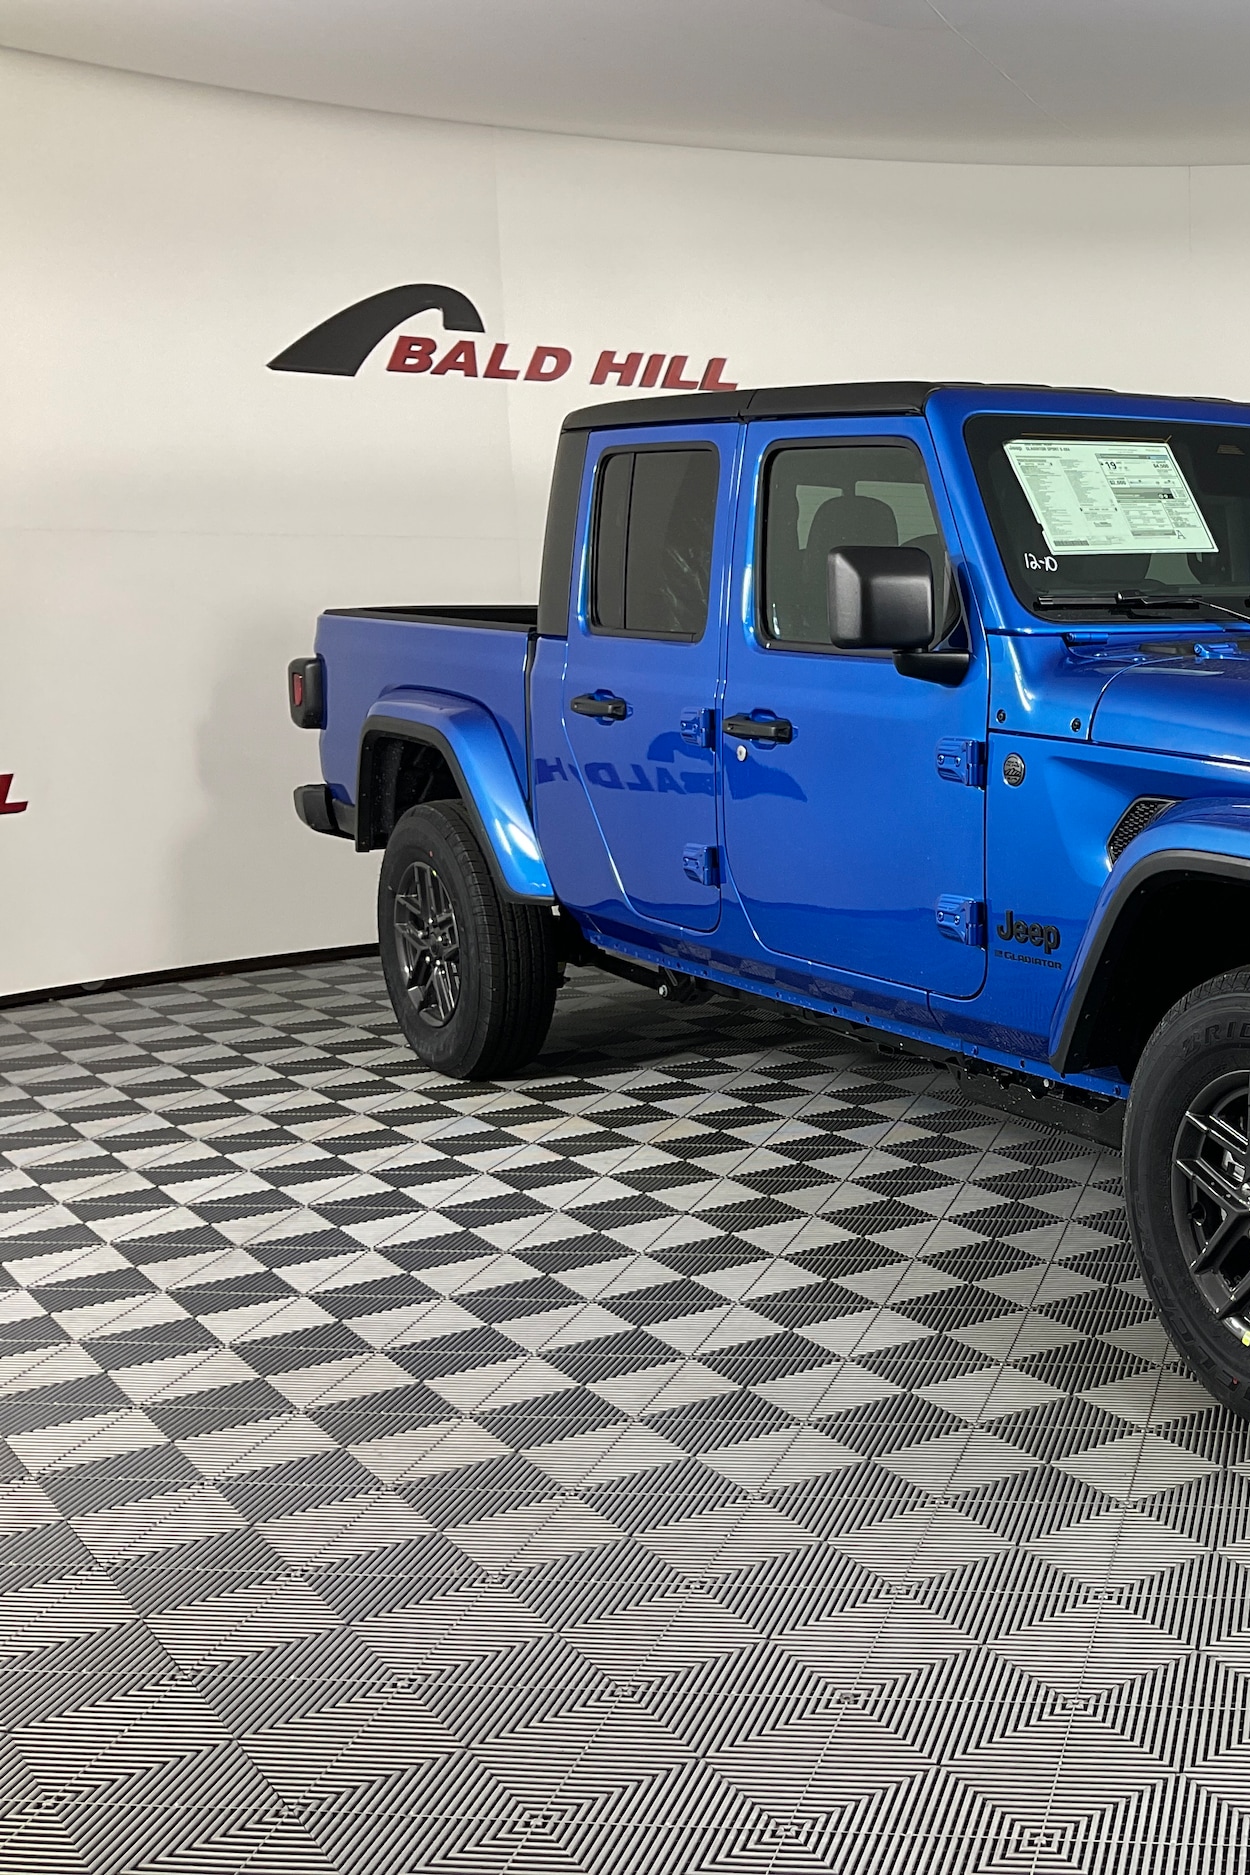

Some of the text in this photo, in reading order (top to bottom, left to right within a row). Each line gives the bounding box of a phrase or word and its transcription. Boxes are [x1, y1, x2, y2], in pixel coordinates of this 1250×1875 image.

[386, 335, 738, 391] BALD HILL
[1105, 461, 1117, 470] 19
[1024, 553, 1058, 571] 12-10
[997, 910, 1061, 955] Jeep
[1004, 951, 1062, 970] GLADIATOR
